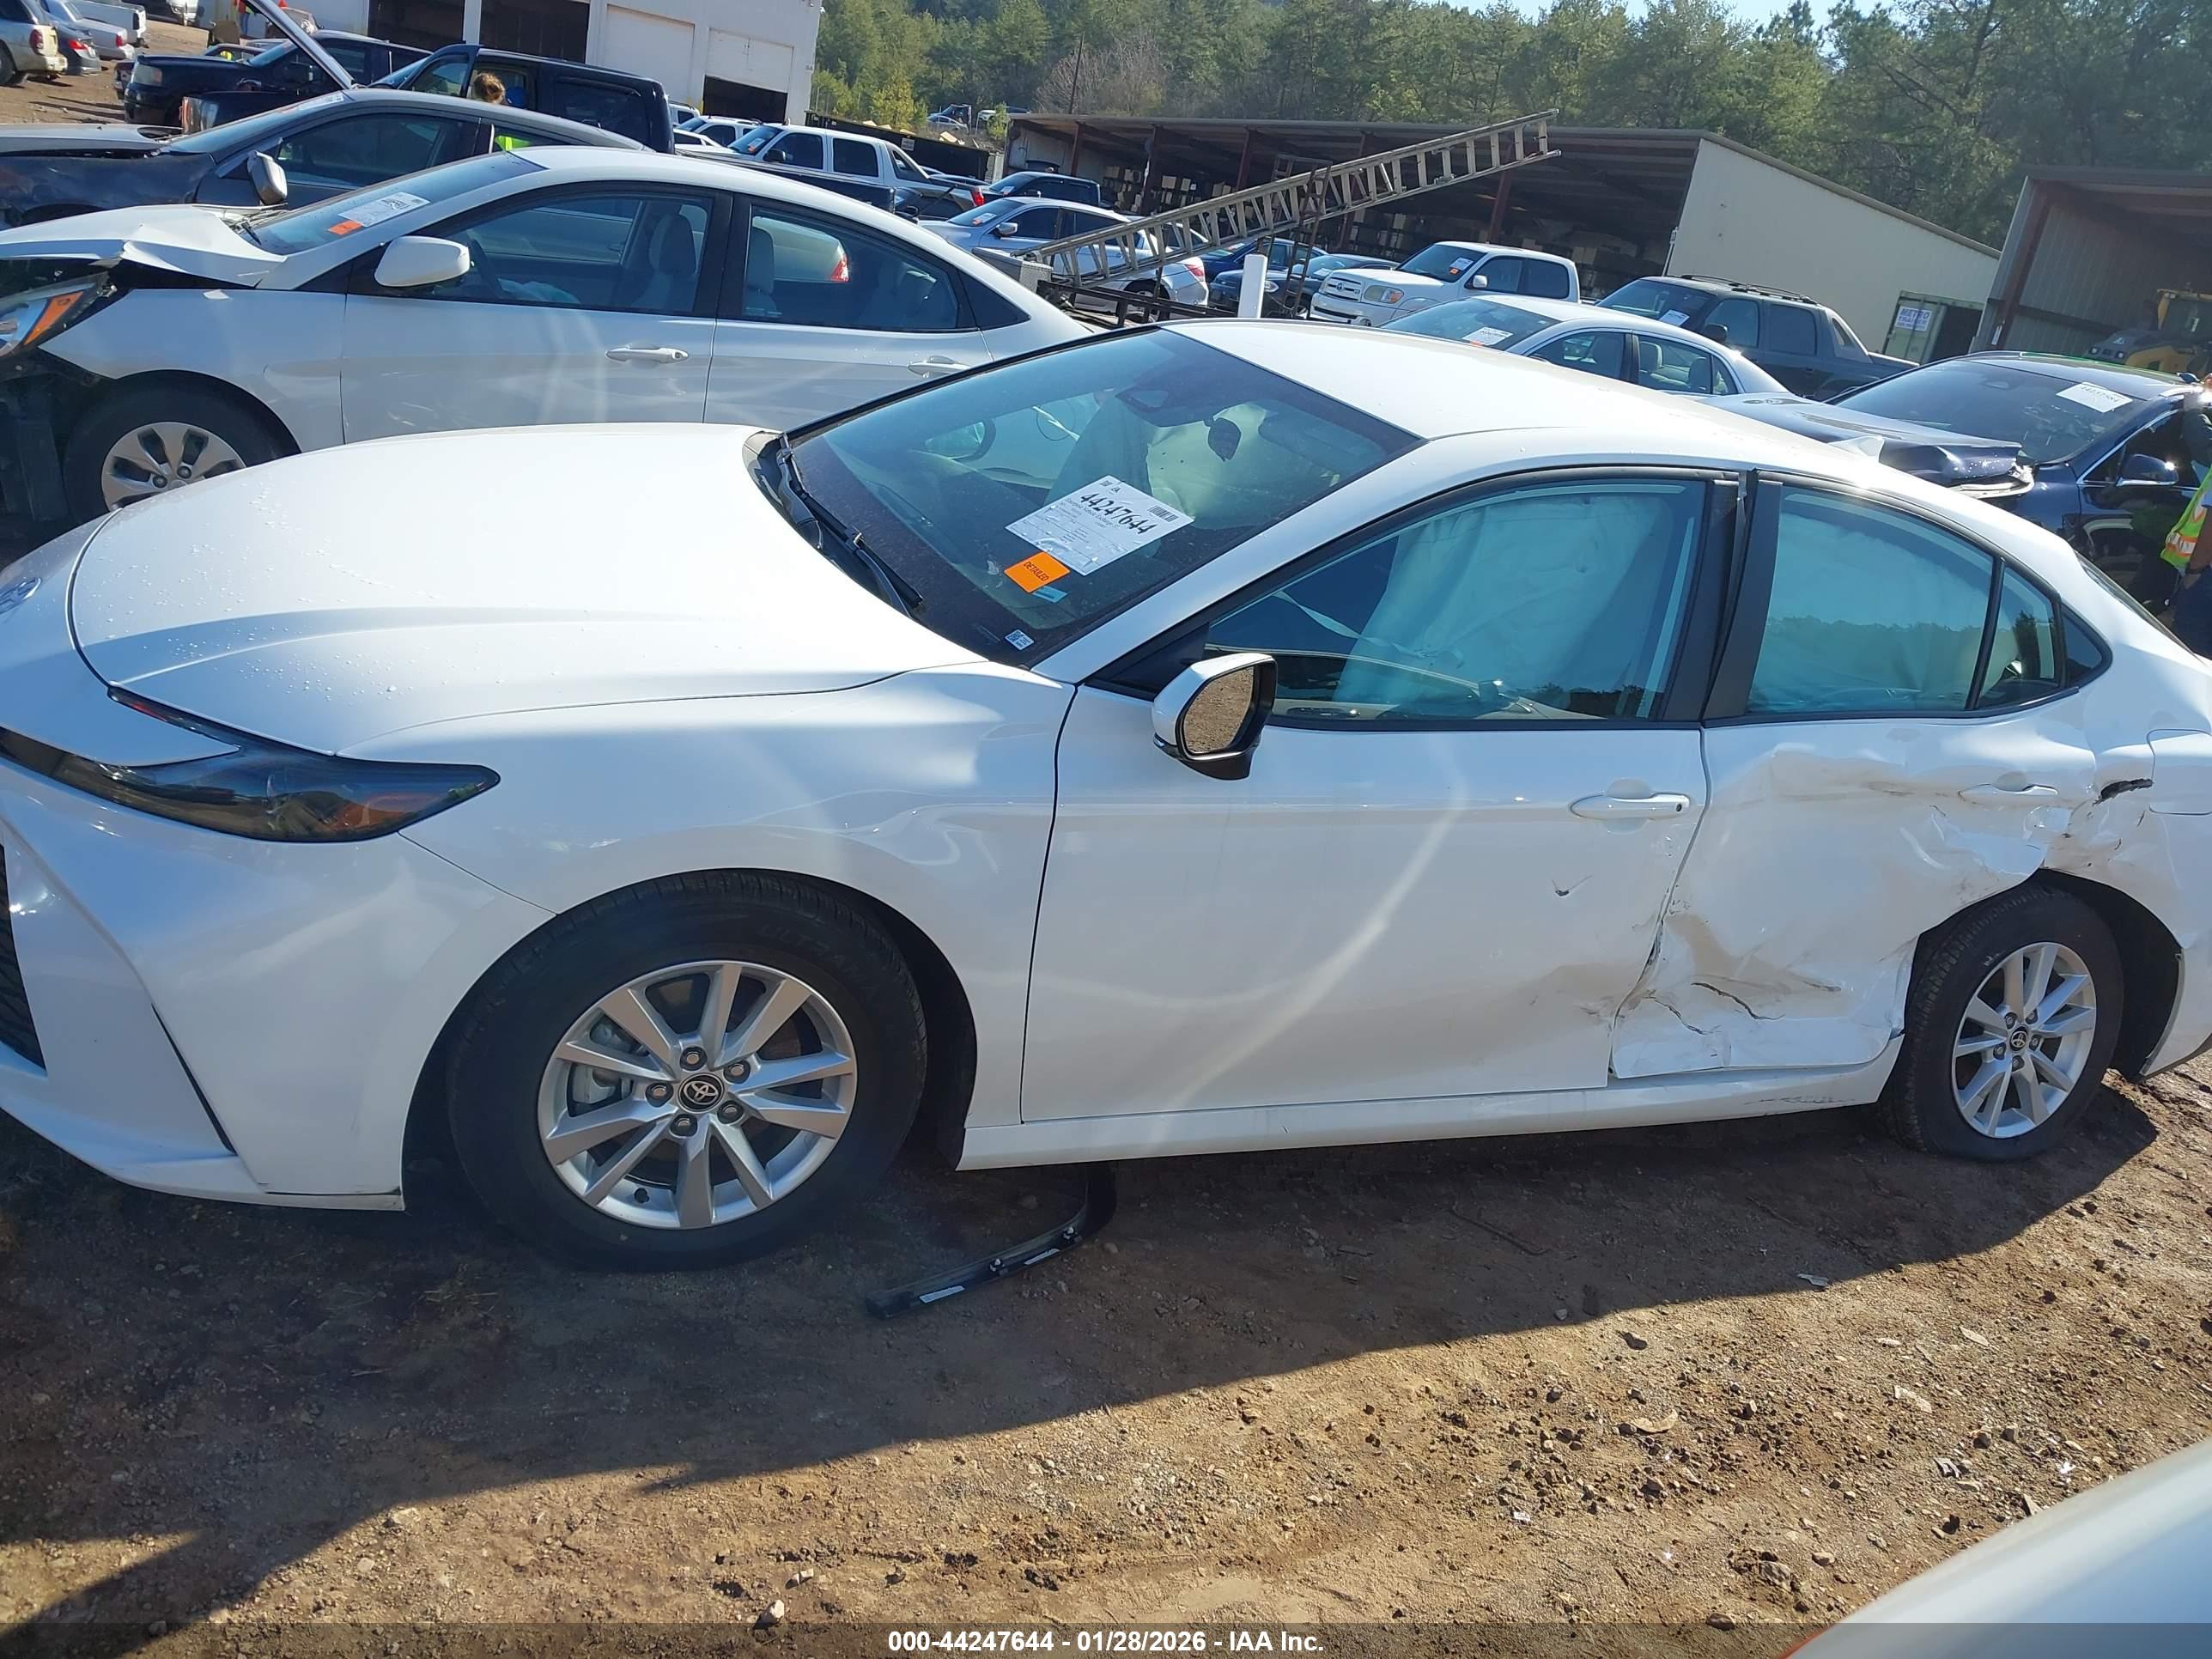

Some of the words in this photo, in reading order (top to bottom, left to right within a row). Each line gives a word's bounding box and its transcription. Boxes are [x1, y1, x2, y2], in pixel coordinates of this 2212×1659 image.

[1899, 316, 1929, 325] TRAIER
[1080, 493, 1158, 535] 44247644
[1023, 561, 1050, 581] DETAILED
